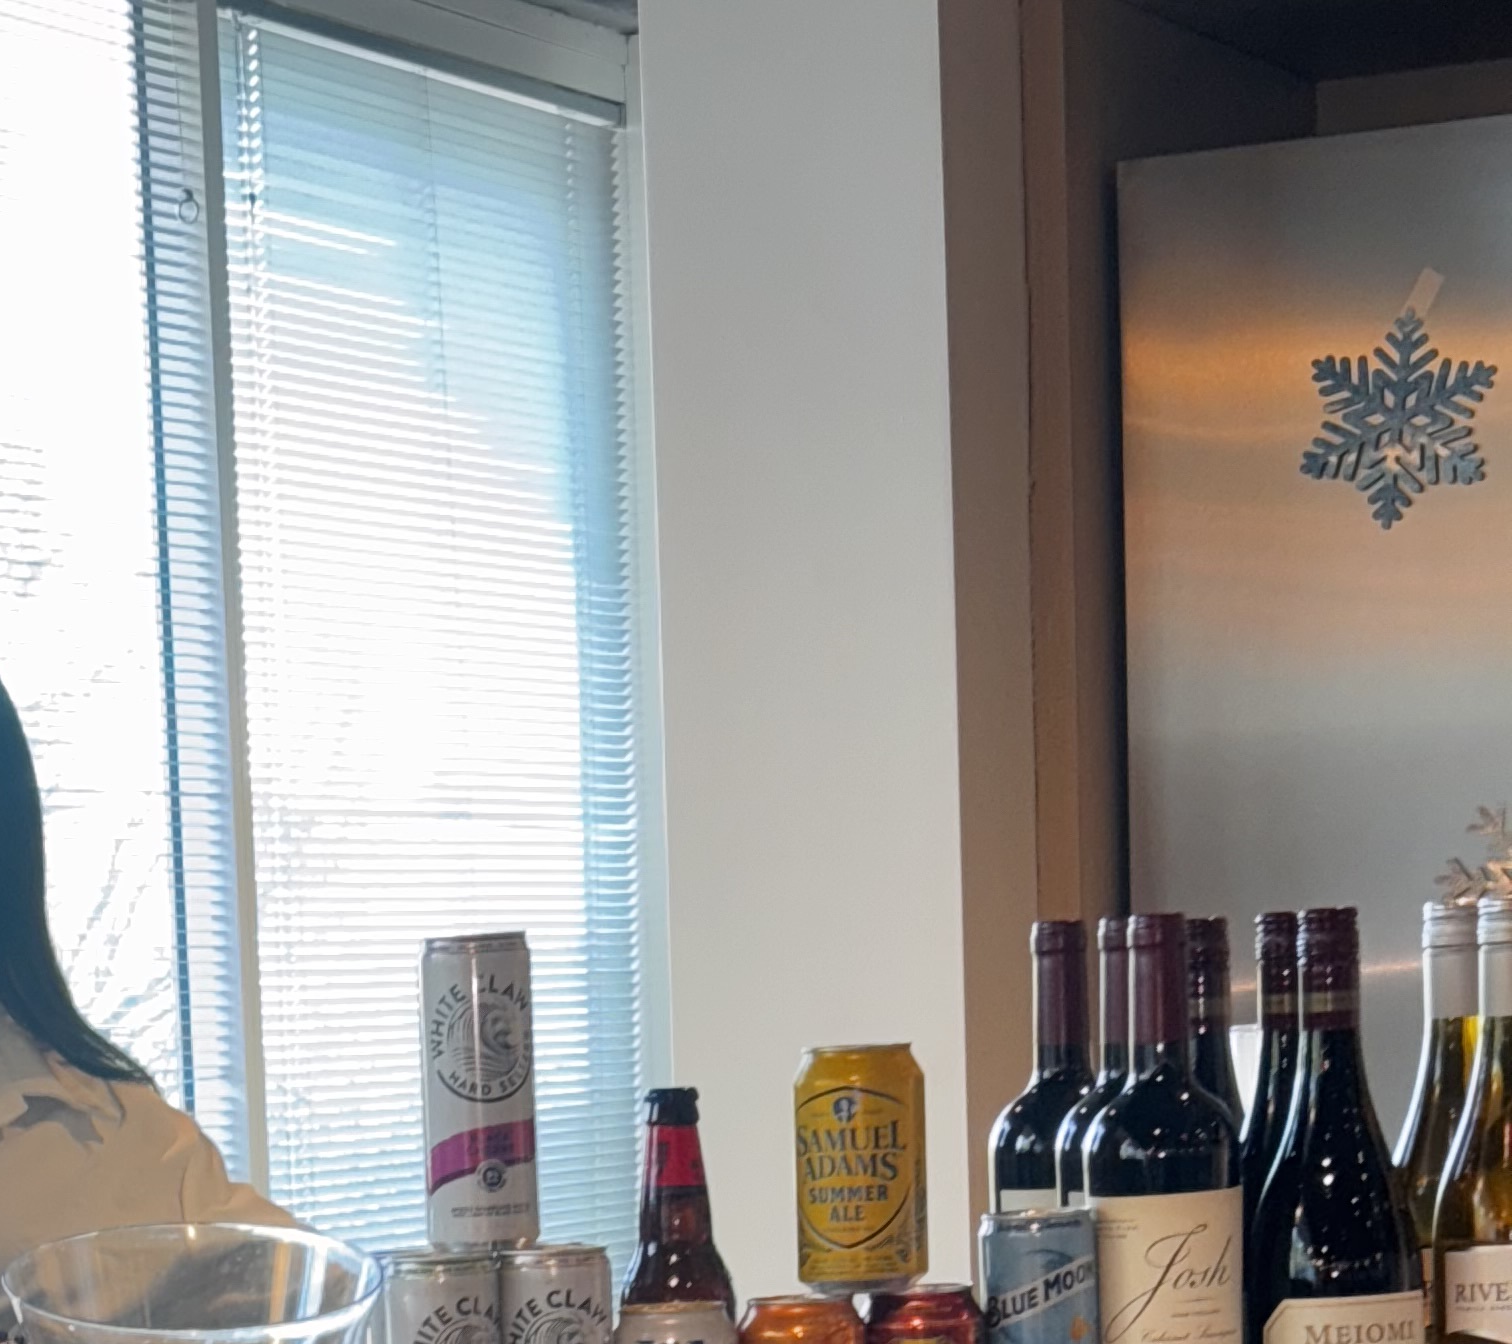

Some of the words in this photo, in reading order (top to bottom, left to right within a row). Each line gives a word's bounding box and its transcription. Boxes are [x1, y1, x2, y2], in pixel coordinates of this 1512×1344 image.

[431, 983, 466, 1060] WHITE
[449, 1071, 492, 1097] HARD
[797, 1120, 906, 1157] SAMUEL
[805, 1152, 898, 1181] ADAMS
[809, 1184, 888, 1204] SUMMER
[829, 1205, 865, 1222] ALE
[1104, 1223, 1231, 1344] Josh
[1455, 1282, 1512, 1304] RIVE
[546, 1288, 608, 1327] CLAW
[988, 1286, 1039, 1329] BLUE
